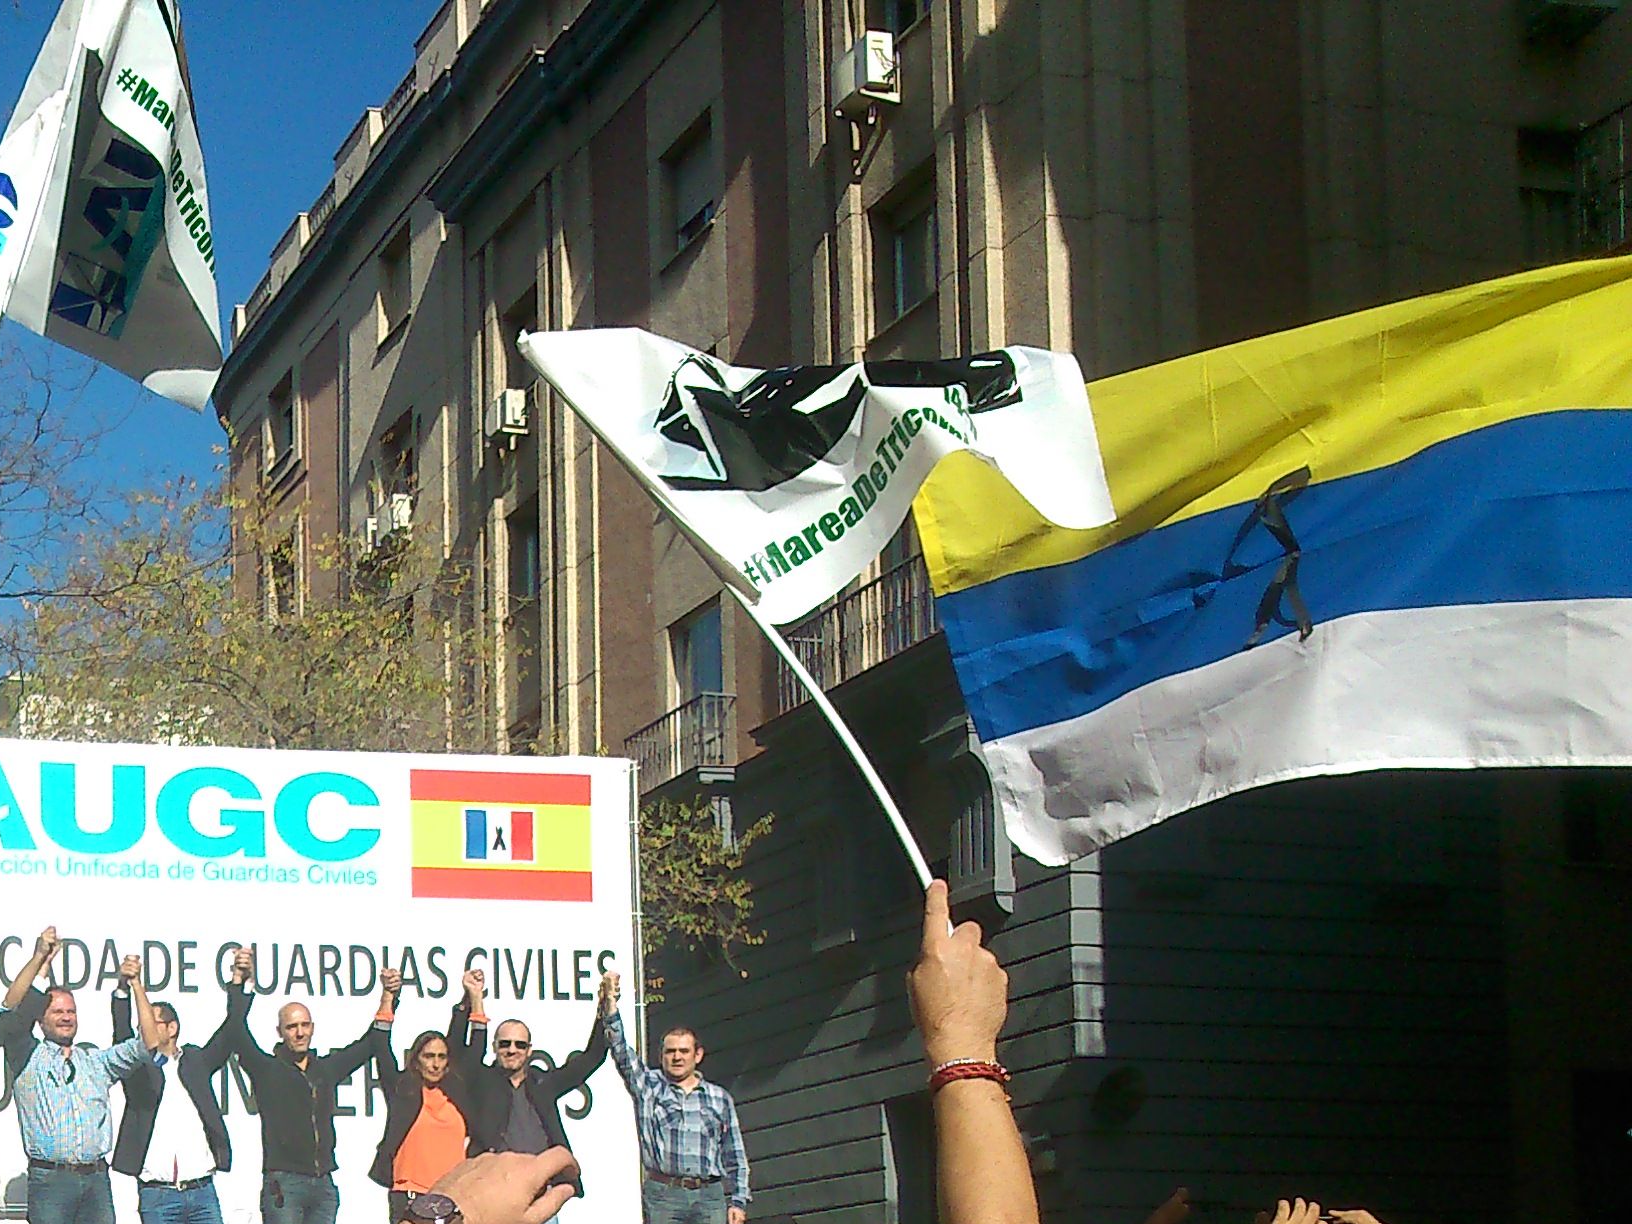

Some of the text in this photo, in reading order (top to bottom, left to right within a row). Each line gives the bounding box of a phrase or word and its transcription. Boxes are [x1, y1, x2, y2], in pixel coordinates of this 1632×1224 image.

[54, 856, 162, 880] Unificada
[167, 860, 195, 881] de
[201, 860, 300, 884] Guardias
[306, 863, 378, 887] Civiles
[143, 940, 199, 993] DE
